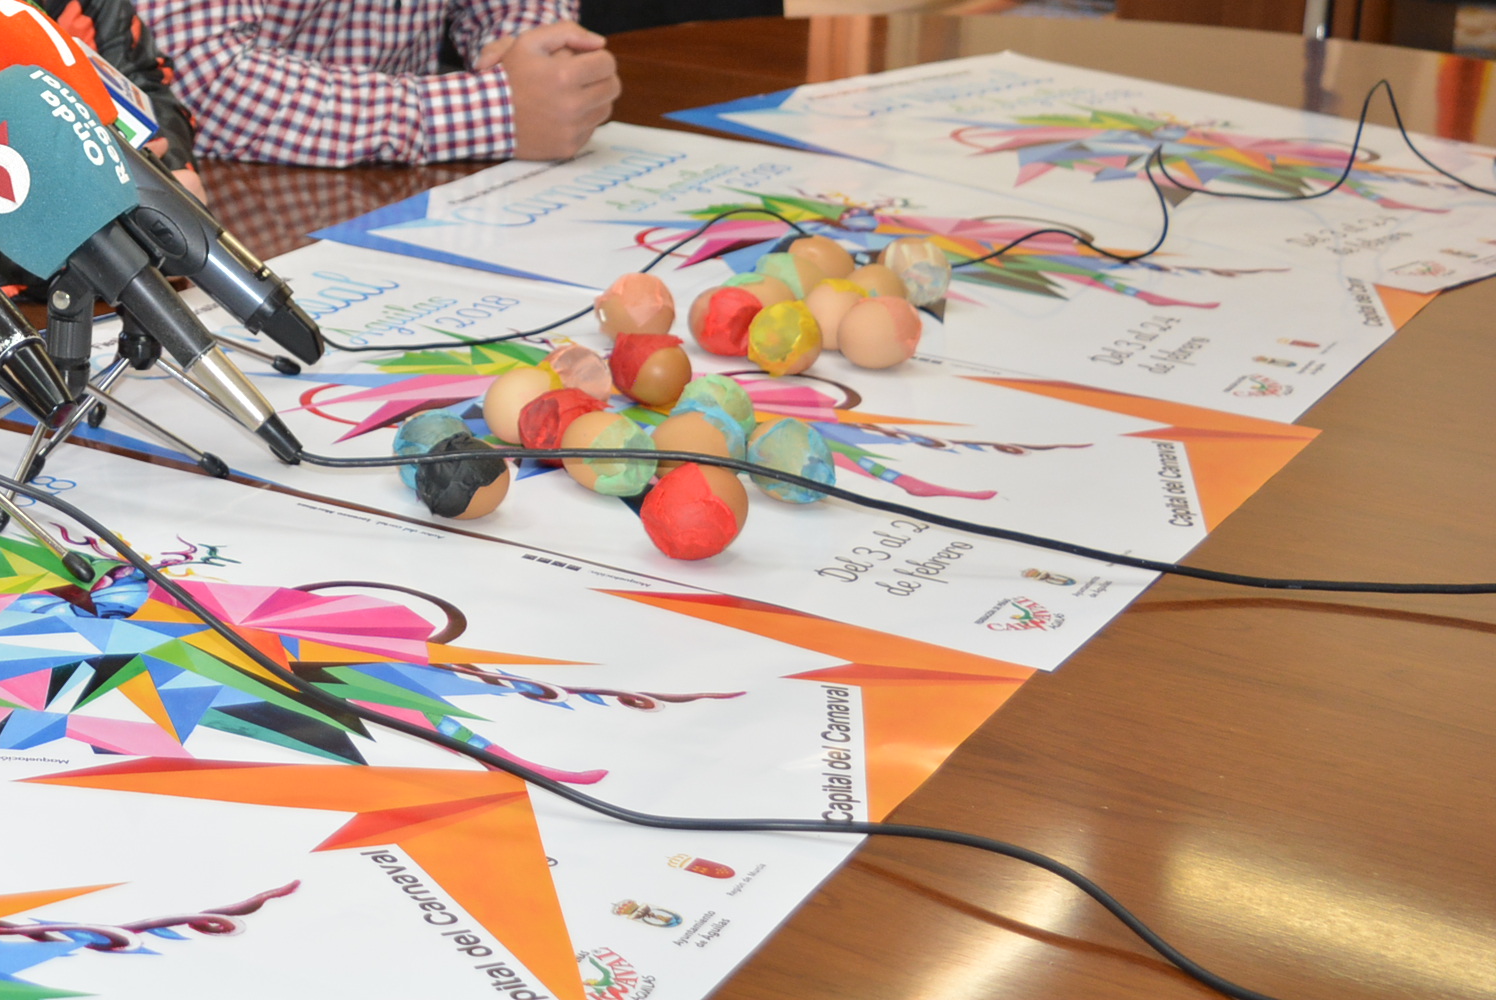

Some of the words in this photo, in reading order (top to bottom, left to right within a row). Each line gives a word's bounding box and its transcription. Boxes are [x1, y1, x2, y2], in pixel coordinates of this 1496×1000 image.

[29, 70, 132, 185] Regional
[40, 89, 105, 166] Onda
[435, 295, 520, 329] 2018
[1163, 495, 1197, 527] Capital
[814, 556, 874, 582] Del
[852, 546, 891, 561] 3
[872, 530, 911, 548] al
[893, 541, 974, 584] febrero
[875, 580, 921, 597] de
[820, 685, 851, 743] Carnaval
[821, 745, 852, 770] del
[821, 772, 861, 825] Capital
[360, 849, 459, 926] Carnaval
[440, 929, 494, 957] del
